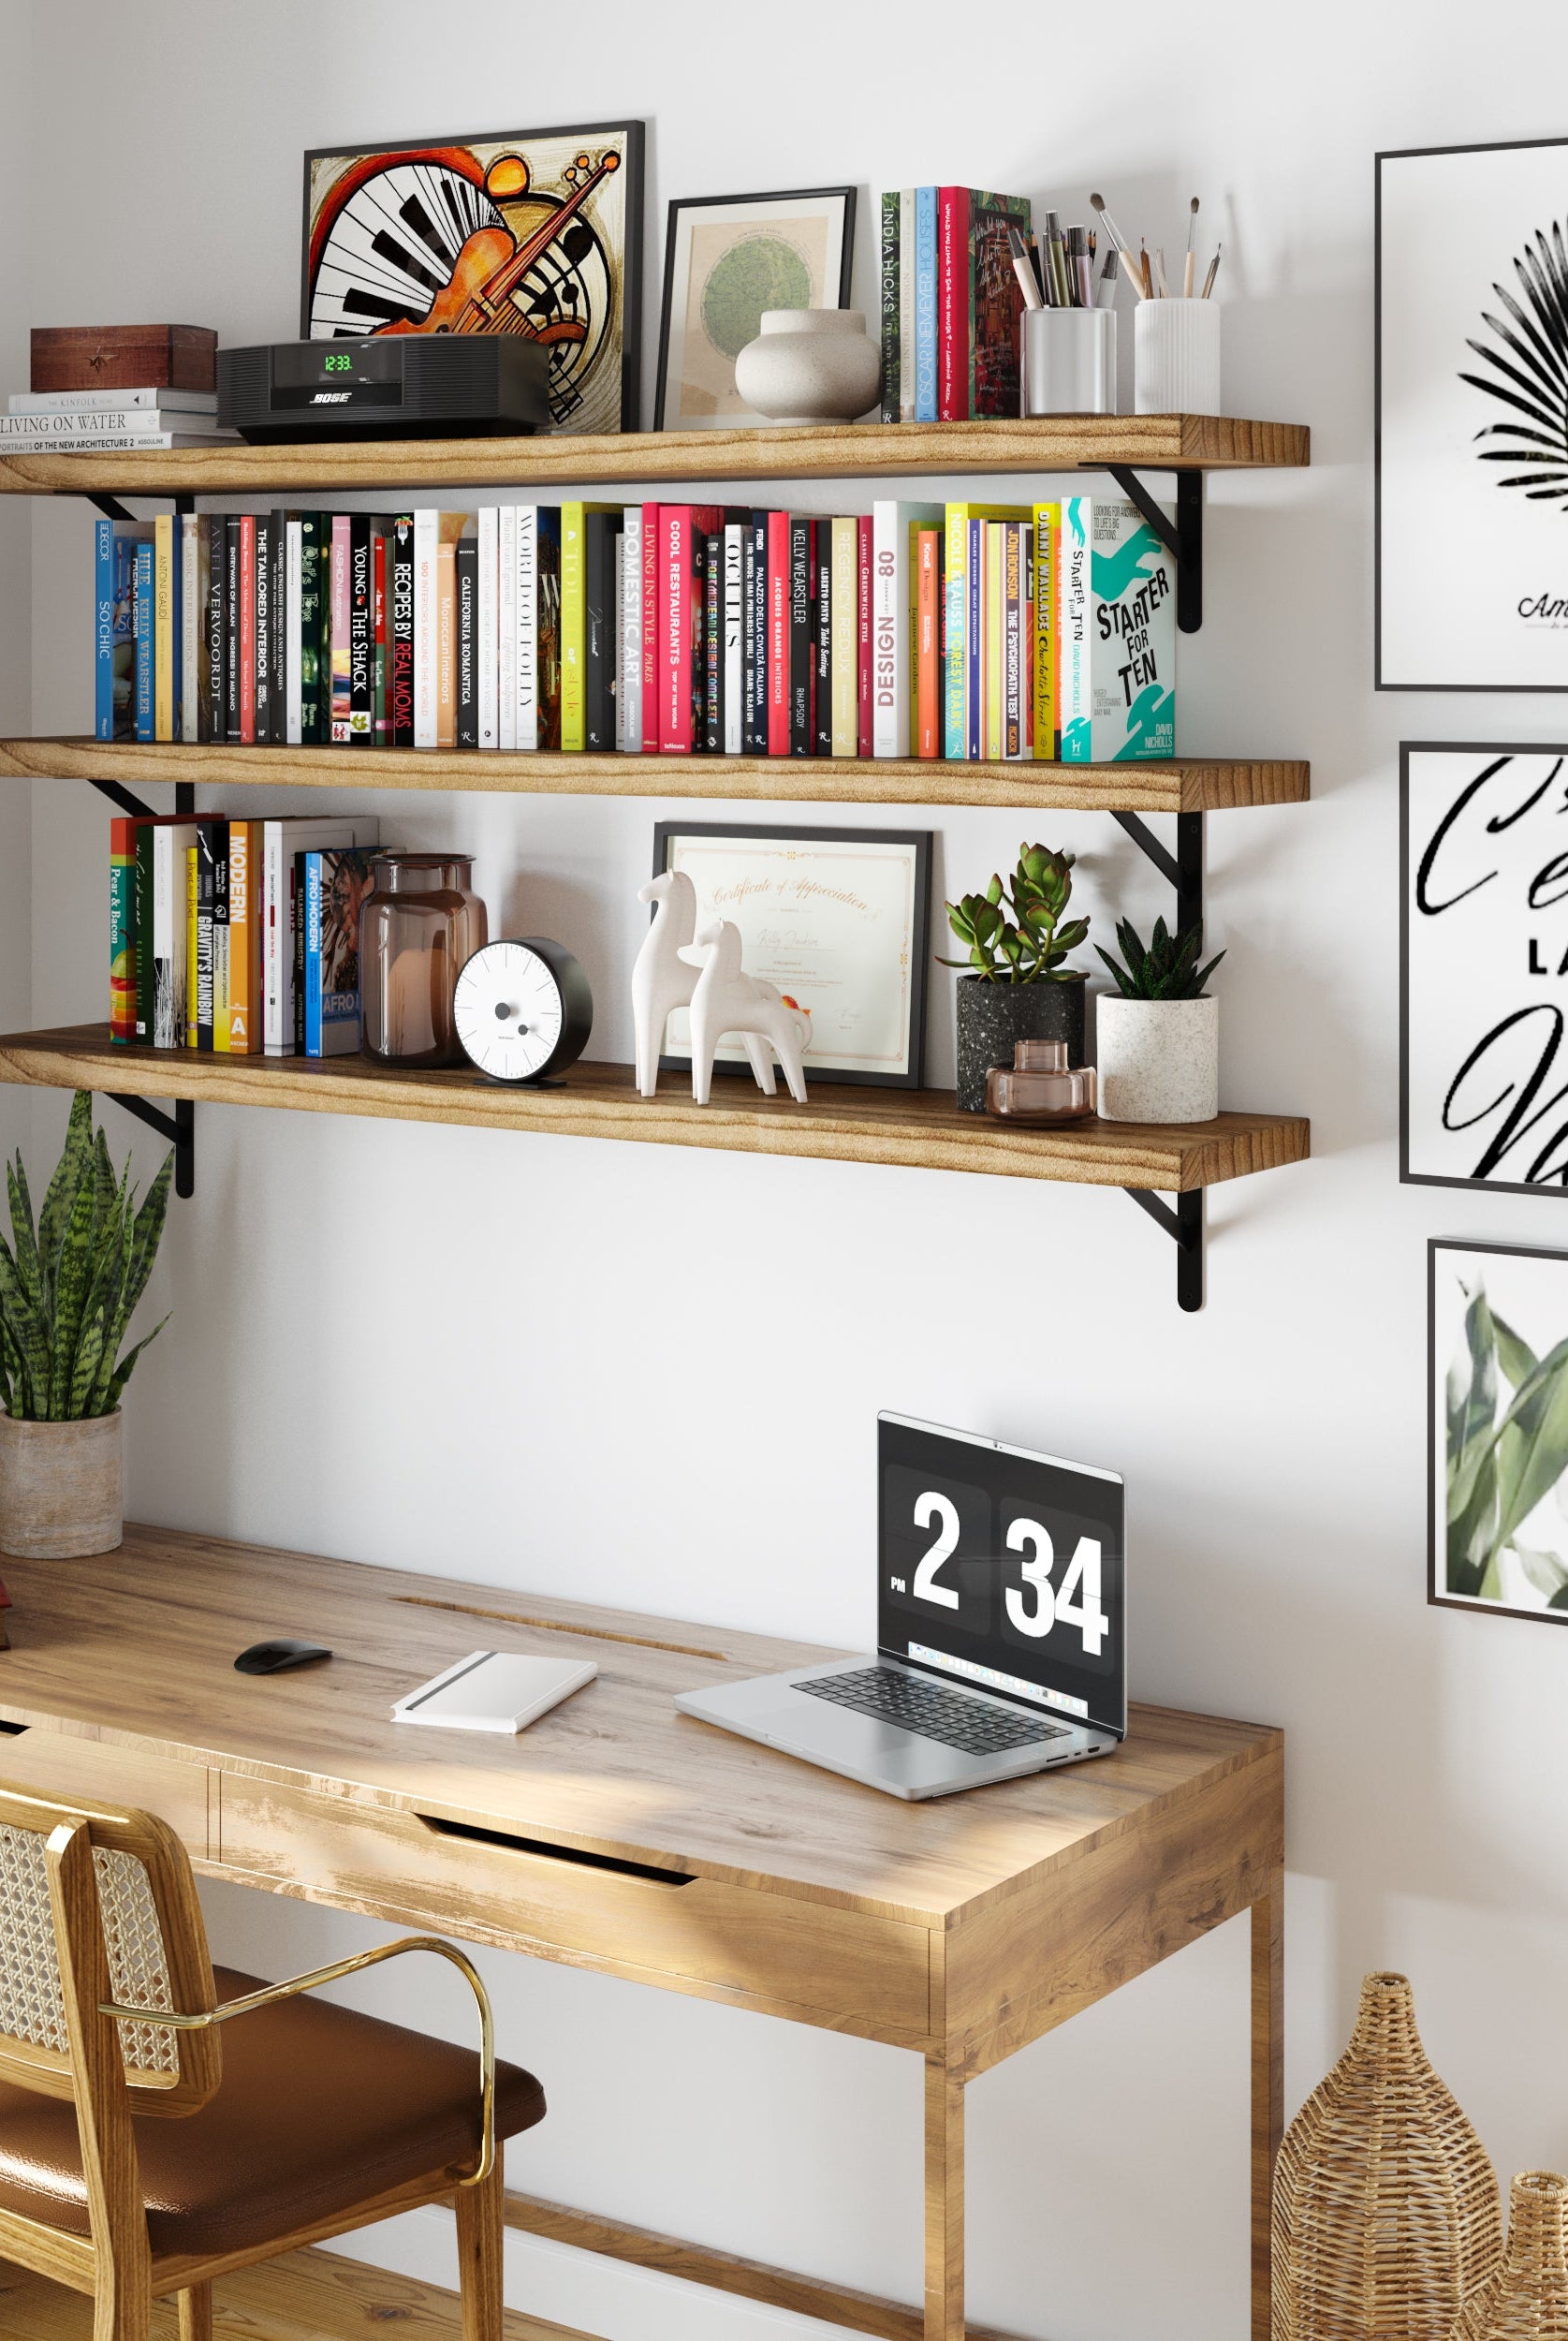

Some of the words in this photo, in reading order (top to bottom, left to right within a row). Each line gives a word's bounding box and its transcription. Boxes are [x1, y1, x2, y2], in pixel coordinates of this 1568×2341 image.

[884, 207, 893, 252] INDIA
[920, 210, 931, 270] HOUSES
[884, 260, 894, 312] HICKS
[920, 273, 931, 347] NIEMEYER
[309, 392, 352, 404] BOSE
[920, 351, 931, 405] OSCAR
[0, 418, 49, 434] LIVING
[53, 417, 73, 430] ON
[79, 414, 125, 430] WATER
[77, 440, 128, 449] ARCHITECTURE
[100, 529, 109, 561] DECOR
[211, 525, 220, 576] AXEL
[258, 529, 267, 556] THE
[520, 514, 532, 597] WORLD
[645, 523, 654, 574] LIVING
[670, 521, 680, 558] COOL
[794, 529, 805, 558] KELLY
[951, 513, 961, 565] NICOLE
[1007, 530, 1018, 553] JON
[1038, 511, 1048, 560] DANNY
[139, 552, 150, 584] HUE
[258, 557, 267, 616] TAILORED
[355, 546, 367, 595] YOUNG
[625, 521, 639, 639] DOMESTIC
[645, 580, 654, 596] IN
[838, 532, 851, 611] REGENCY
[878, 552, 894, 577] 80
[1007, 554, 1018, 599] RONSON
[1071, 551, 1085, 604] STARTER
[98, 601, 110, 622] SO
[158, 591, 169, 620] GAUDÍ
[229, 591, 235, 600] OF
[395, 563, 411, 619] RECIPES
[462, 577, 471, 640] CALIFORNIA
[670, 563, 680, 665] RESTAURANTS
[708, 560, 718, 627] POSTMODERN
[726, 544, 740, 647] OCULUS
[794, 561, 805, 623] WEARSTLER
[951, 570, 961, 626] KRAUSS
[1038, 565, 1048, 631] WALLACE
[1097, 567, 1169, 640] STARTER
[139, 598, 149, 637] KELLY
[353, 609, 367, 640] THE
[396, 623, 411, 640] BY
[441, 597, 450, 655] Moroccan
[645, 600, 654, 645] STYLE
[820, 627, 829, 647] Table
[909, 607, 918, 647] Japanese
[1008, 610, 1018, 628] THE
[1071, 614, 1083, 640] TEN
[98, 625, 110, 658] CHIC
[211, 583, 220, 700] VERVOORDT
[258, 619, 267, 678] INTERIOR
[395, 643, 411, 677] REAL
[708, 631, 718, 669] DESIGN
[756, 634, 765, 665] CIVILTÀ
[819, 649, 829, 677] Settings
[838, 618, 851, 674] REDUX
[878, 617, 894, 707] DESIGN
[951, 632, 961, 685] FOREST
[1007, 631, 1018, 695] PSYCHOPATH
[1039, 636, 1049, 689] Charlotte
[1127, 629, 1149, 660] FOR
[139, 641, 149, 714] WEARSTLER
[353, 642, 368, 692] SHACK
[441, 655, 450, 703] Interiors
[462, 643, 471, 704] ROMANTICA
[520, 640, 532, 707] FOLLY
[625, 645, 639, 686] ART
[644, 653, 653, 684] PARIS
[1118, 649, 1157, 708] TEN
[395, 681, 411, 728] MOMS
[672, 685, 677, 695] OF
[708, 671, 718, 724] COMPLETE
[951, 689, 961, 729] DARK
[1007, 697, 1018, 720] TEST
[1038, 694, 1050, 727] Street
[1145, 736, 1172, 749] NICHOLLS
[1156, 724, 1172, 735] DAVID
[111, 868, 121, 896] Pear
[230, 836, 246, 922] MODERN
[309, 867, 318, 900] AFRO
[111, 898, 121, 910] &
[309, 901, 318, 952] MODERN
[111, 913, 121, 944] Bacon
[198, 916, 212, 972] GRAVITY'S
[198, 974, 212, 1026] RAINBOW
[231, 1017, 246, 1036] A
[914, 1491, 960, 1611] 2
[891, 1576, 905, 1593] PM
[1005, 1518, 1109, 1656] 34
